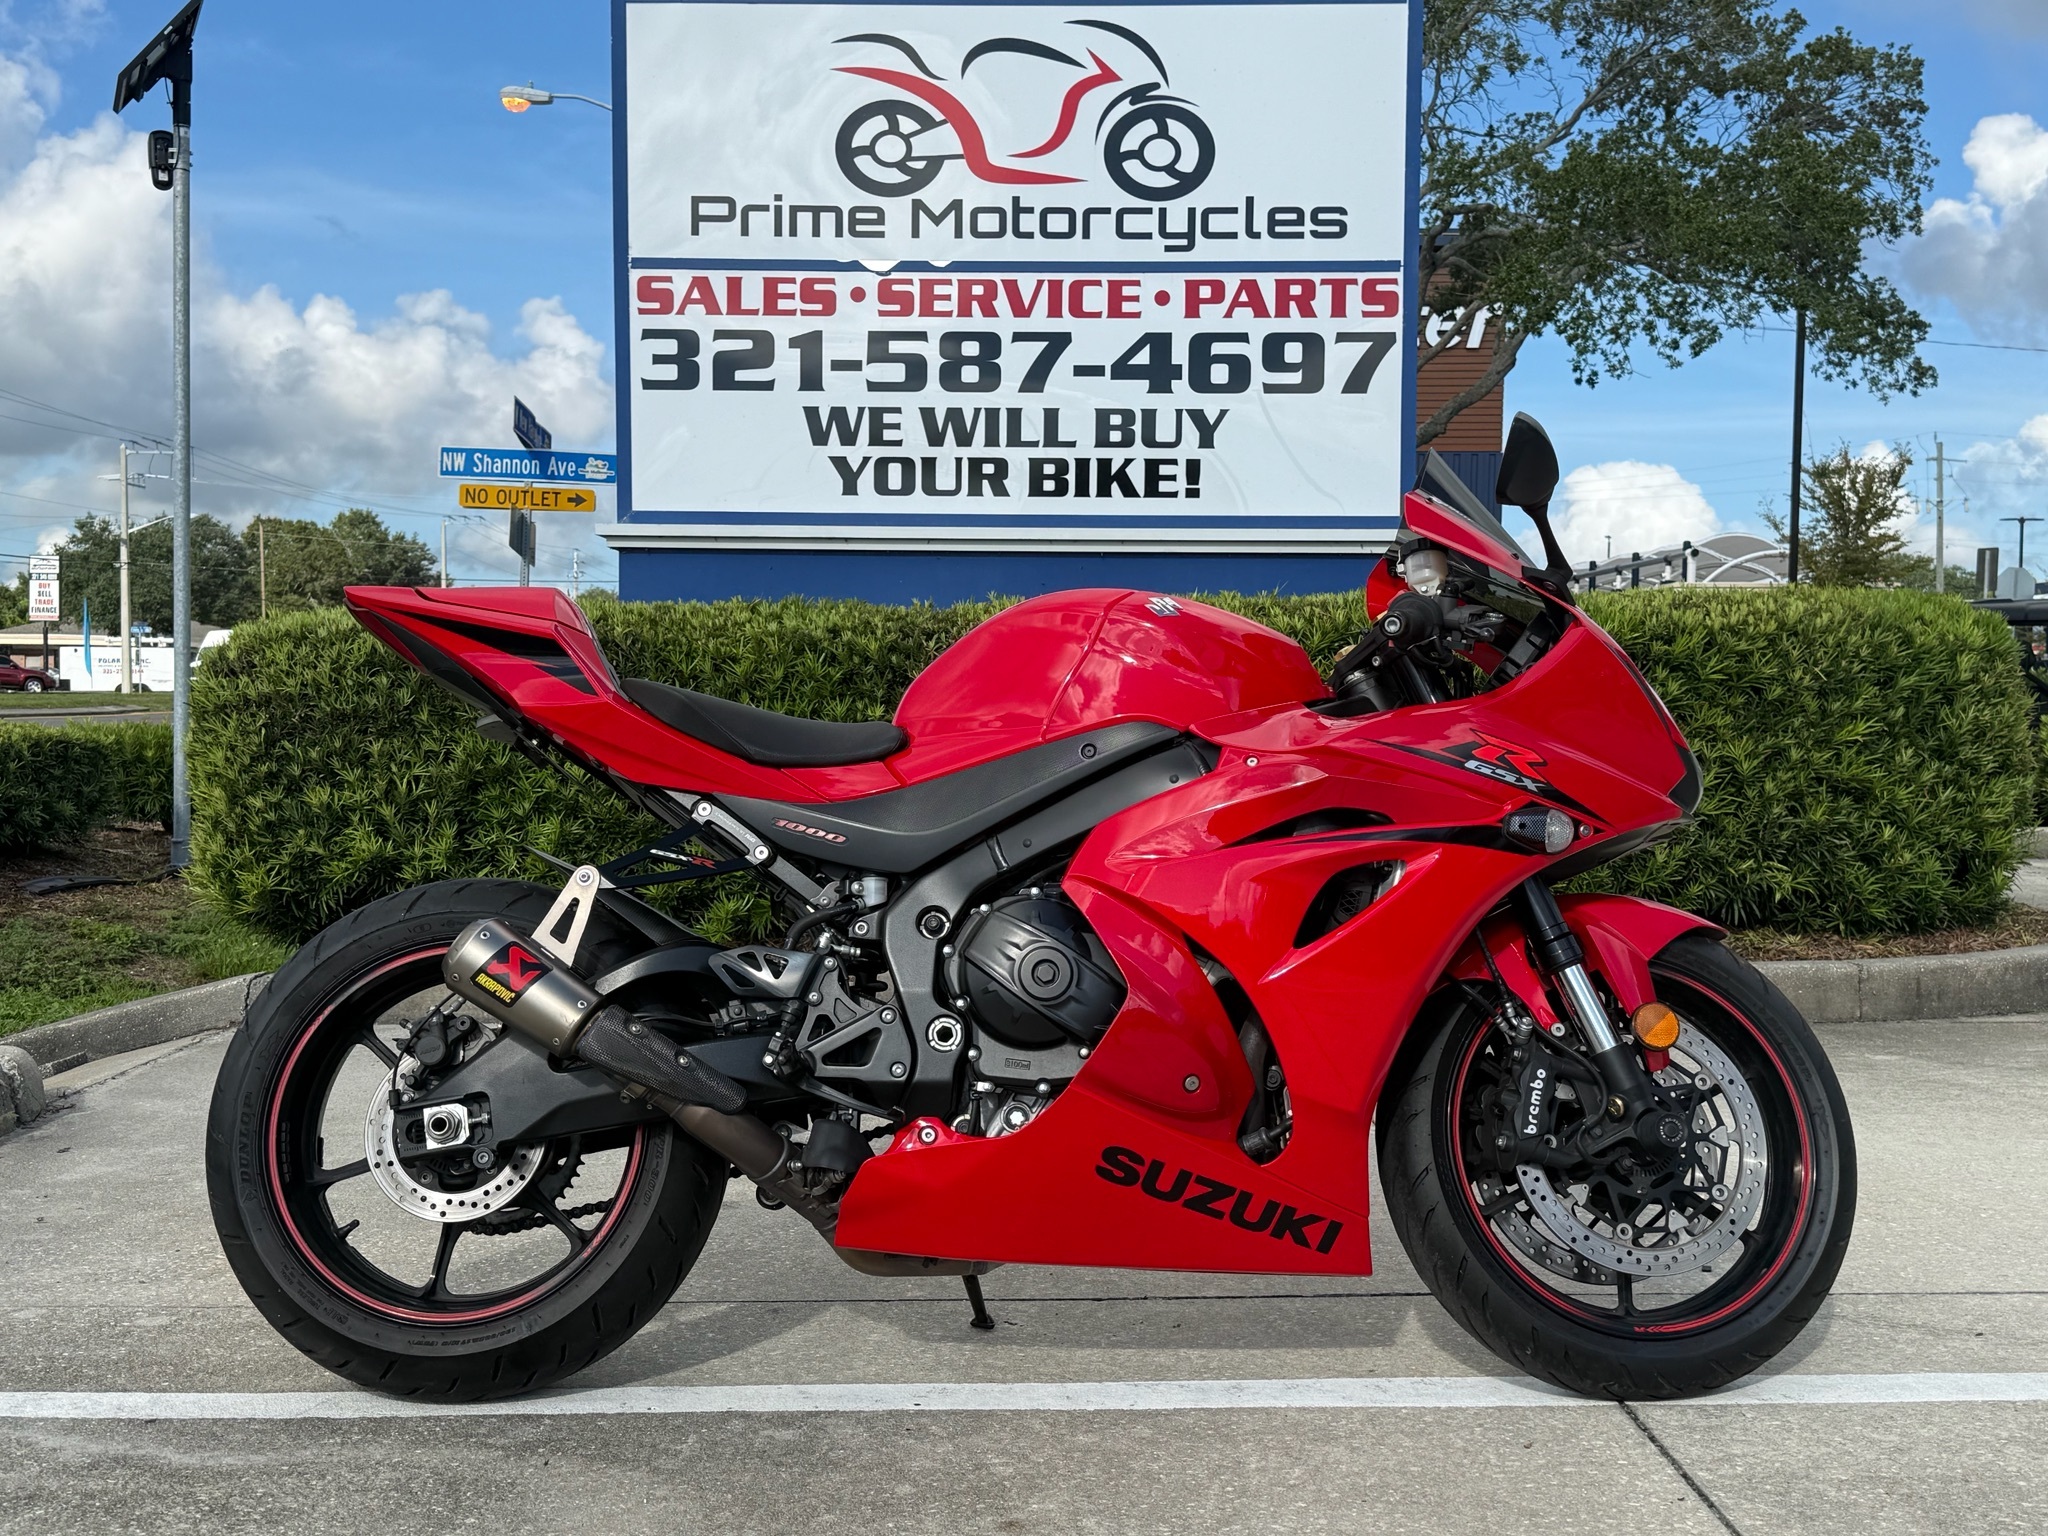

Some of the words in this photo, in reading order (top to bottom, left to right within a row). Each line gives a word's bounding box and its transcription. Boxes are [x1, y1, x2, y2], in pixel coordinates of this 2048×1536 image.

[690, 195, 887, 240] Prime
[910, 196, 1350, 253] Motorcycles
[636, 275, 837, 317] SALES
[878, 278, 1143, 319] SERVICE
[1183, 278, 1400, 319] PARTS
[639, 328, 1398, 395] 321-587-4697
[802, 405, 904, 447] WE
[918, 406, 1078, 449] WILL
[1093, 407, 1230, 450] BUY
[442, 451, 467, 472] NW
[473, 452, 540, 475] Shannon
[547, 456, 577, 477] Ave
[827, 455, 1011, 498] YOUR
[1027, 457, 1202, 499] BIKE!
[464, 487, 489, 504] NO
[496, 489, 562, 507] OUTLET
[31, 606, 57, 614] FINANCE
[1464, 759, 1547, 793] GSX
[773, 817, 847, 843] 1000
[1523, 1067, 1547, 1135] brembo
[1094, 1145, 1345, 1256] SUZUKI
